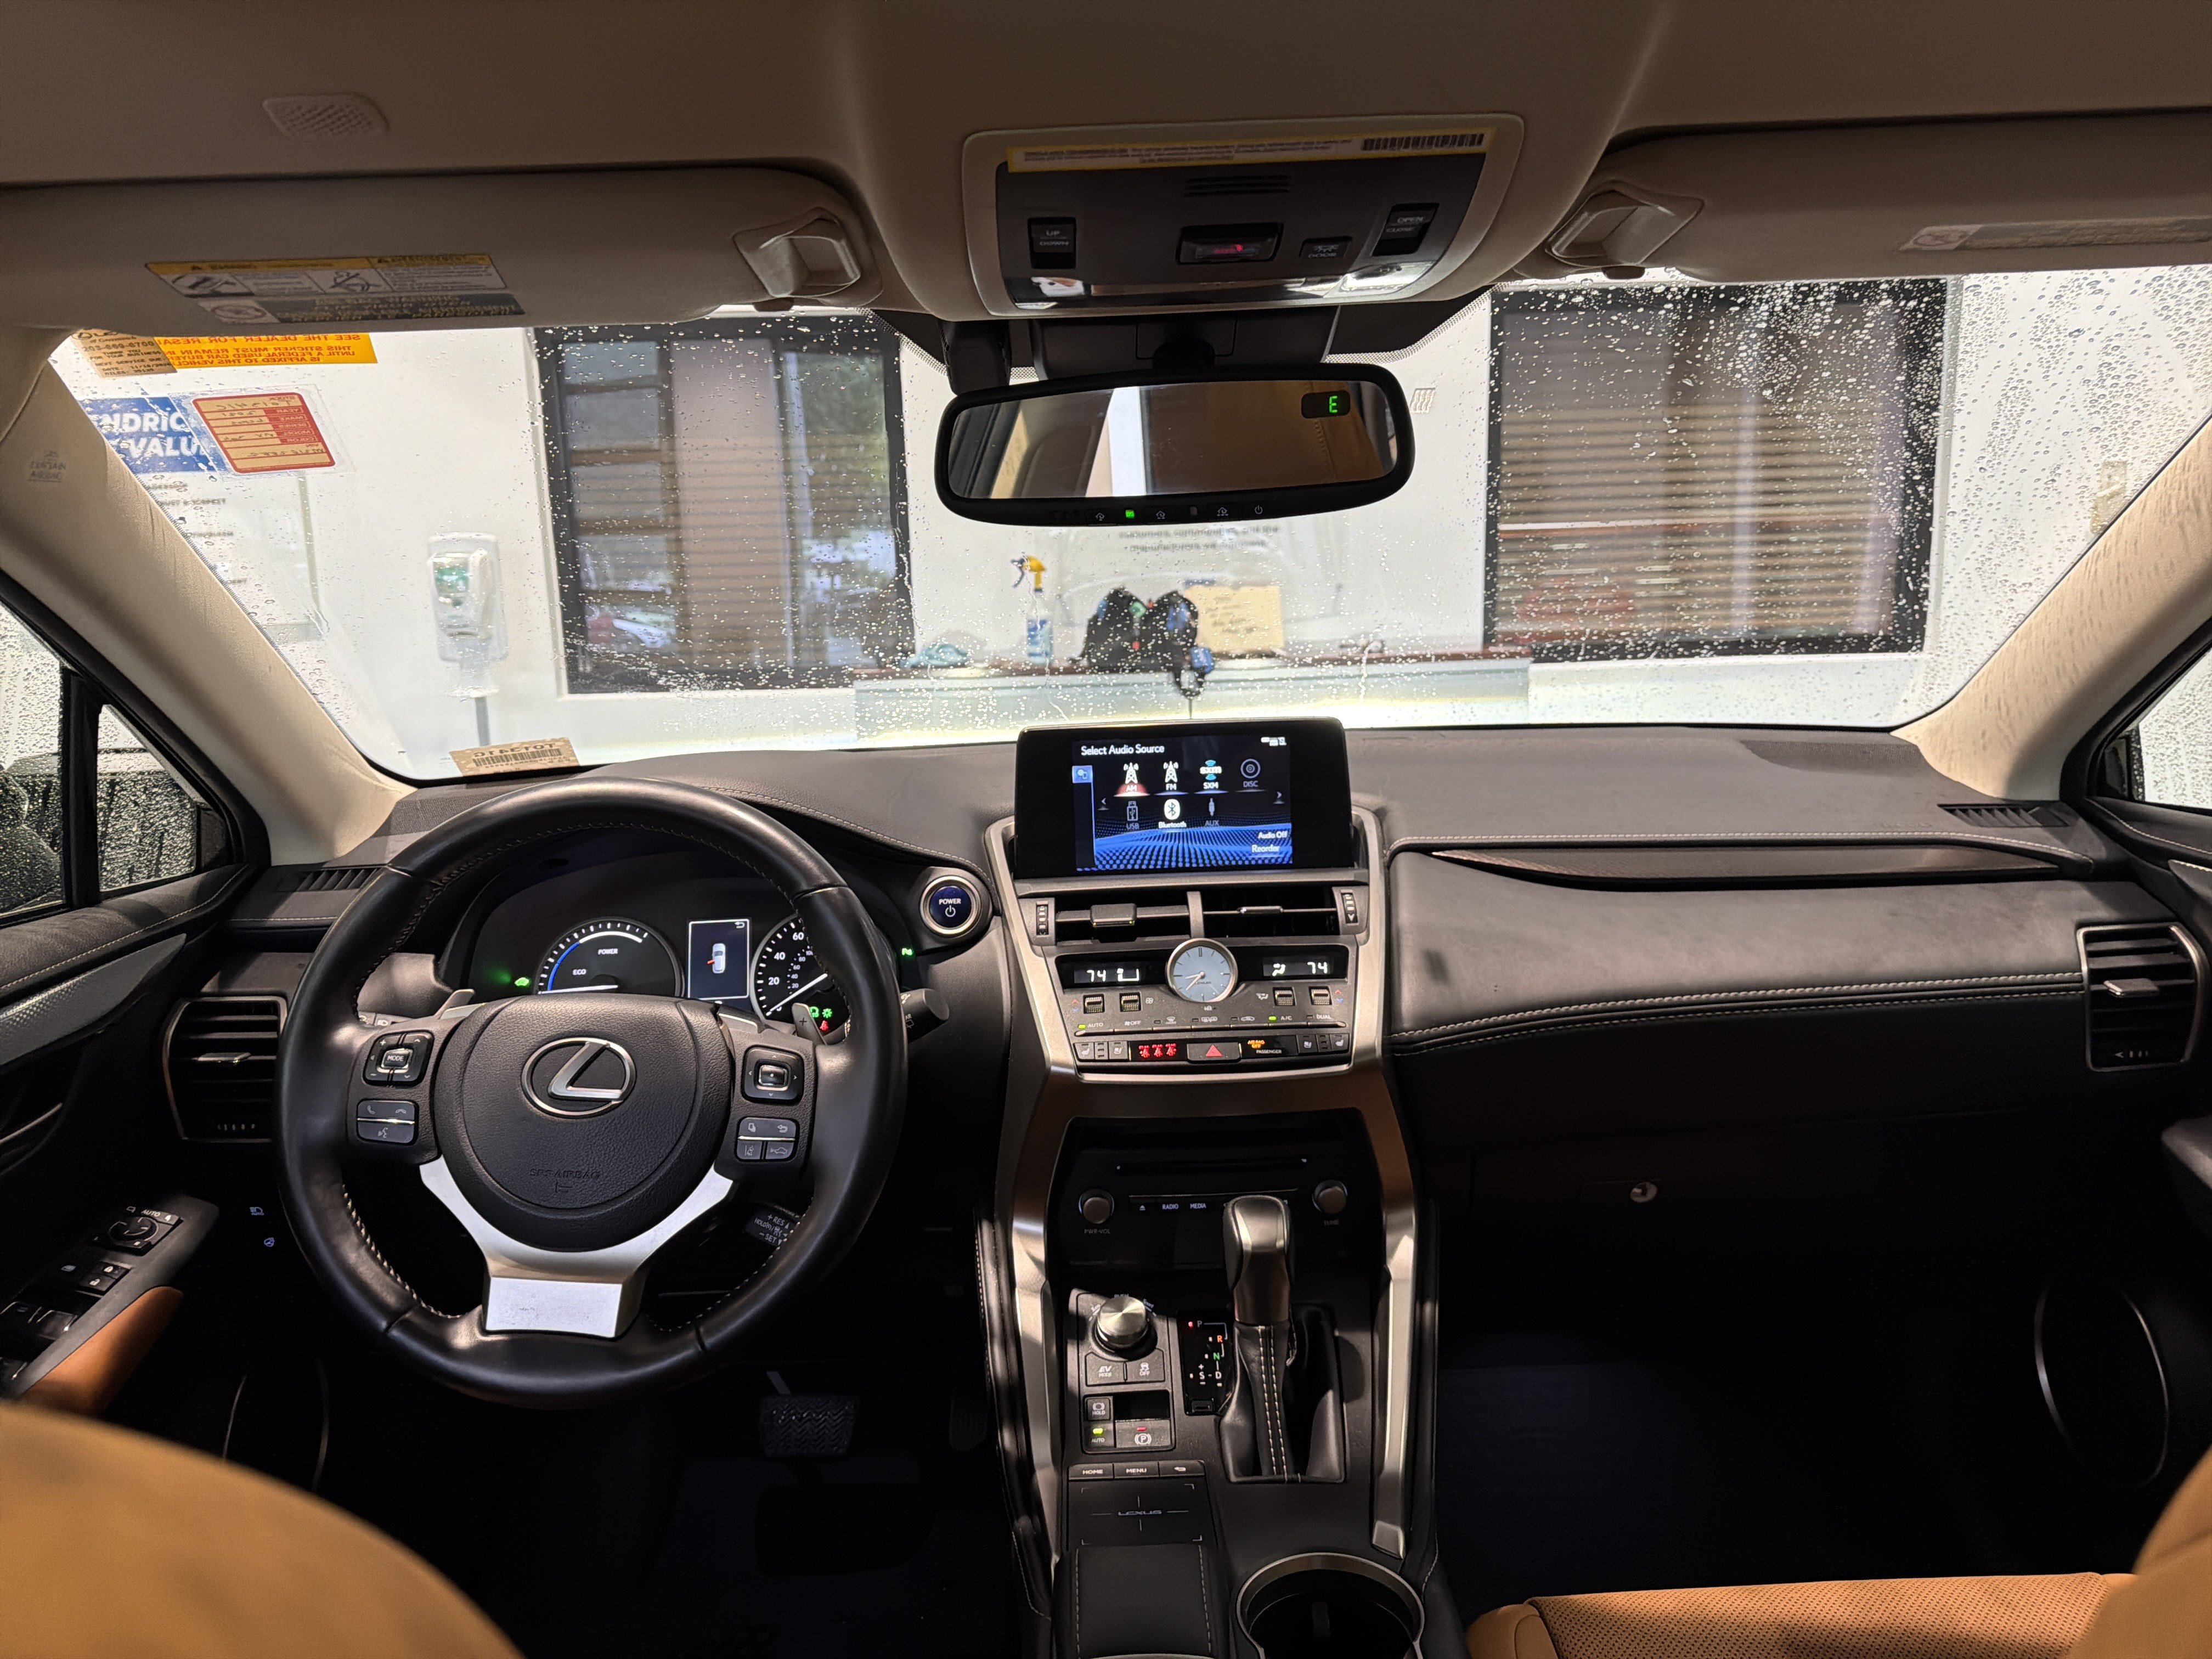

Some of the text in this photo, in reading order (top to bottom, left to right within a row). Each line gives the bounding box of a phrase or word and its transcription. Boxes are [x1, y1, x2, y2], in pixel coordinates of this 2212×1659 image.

[1329, 395, 1339, 414] E
[1081, 743, 1164, 755] Select Audio Source
[1251, 844, 1280, 853] Reorder
[792, 932, 804, 940] 60
[774, 952, 786, 960] 40
[1307, 961, 1328, 974] 74
[1087, 970, 1107, 982] 74
[768, 977, 780, 985] 20
[554, 1169, 600, 1179] AIRBAG
[141, 1209, 160, 1217] AUTO
[773, 1216, 785, 1226] RES
[765, 1234, 777, 1244] SET
[1213, 1352, 1220, 1361] N
[1199, 1371, 1205, 1380] S
[1215, 1371, 1222, 1379] D
